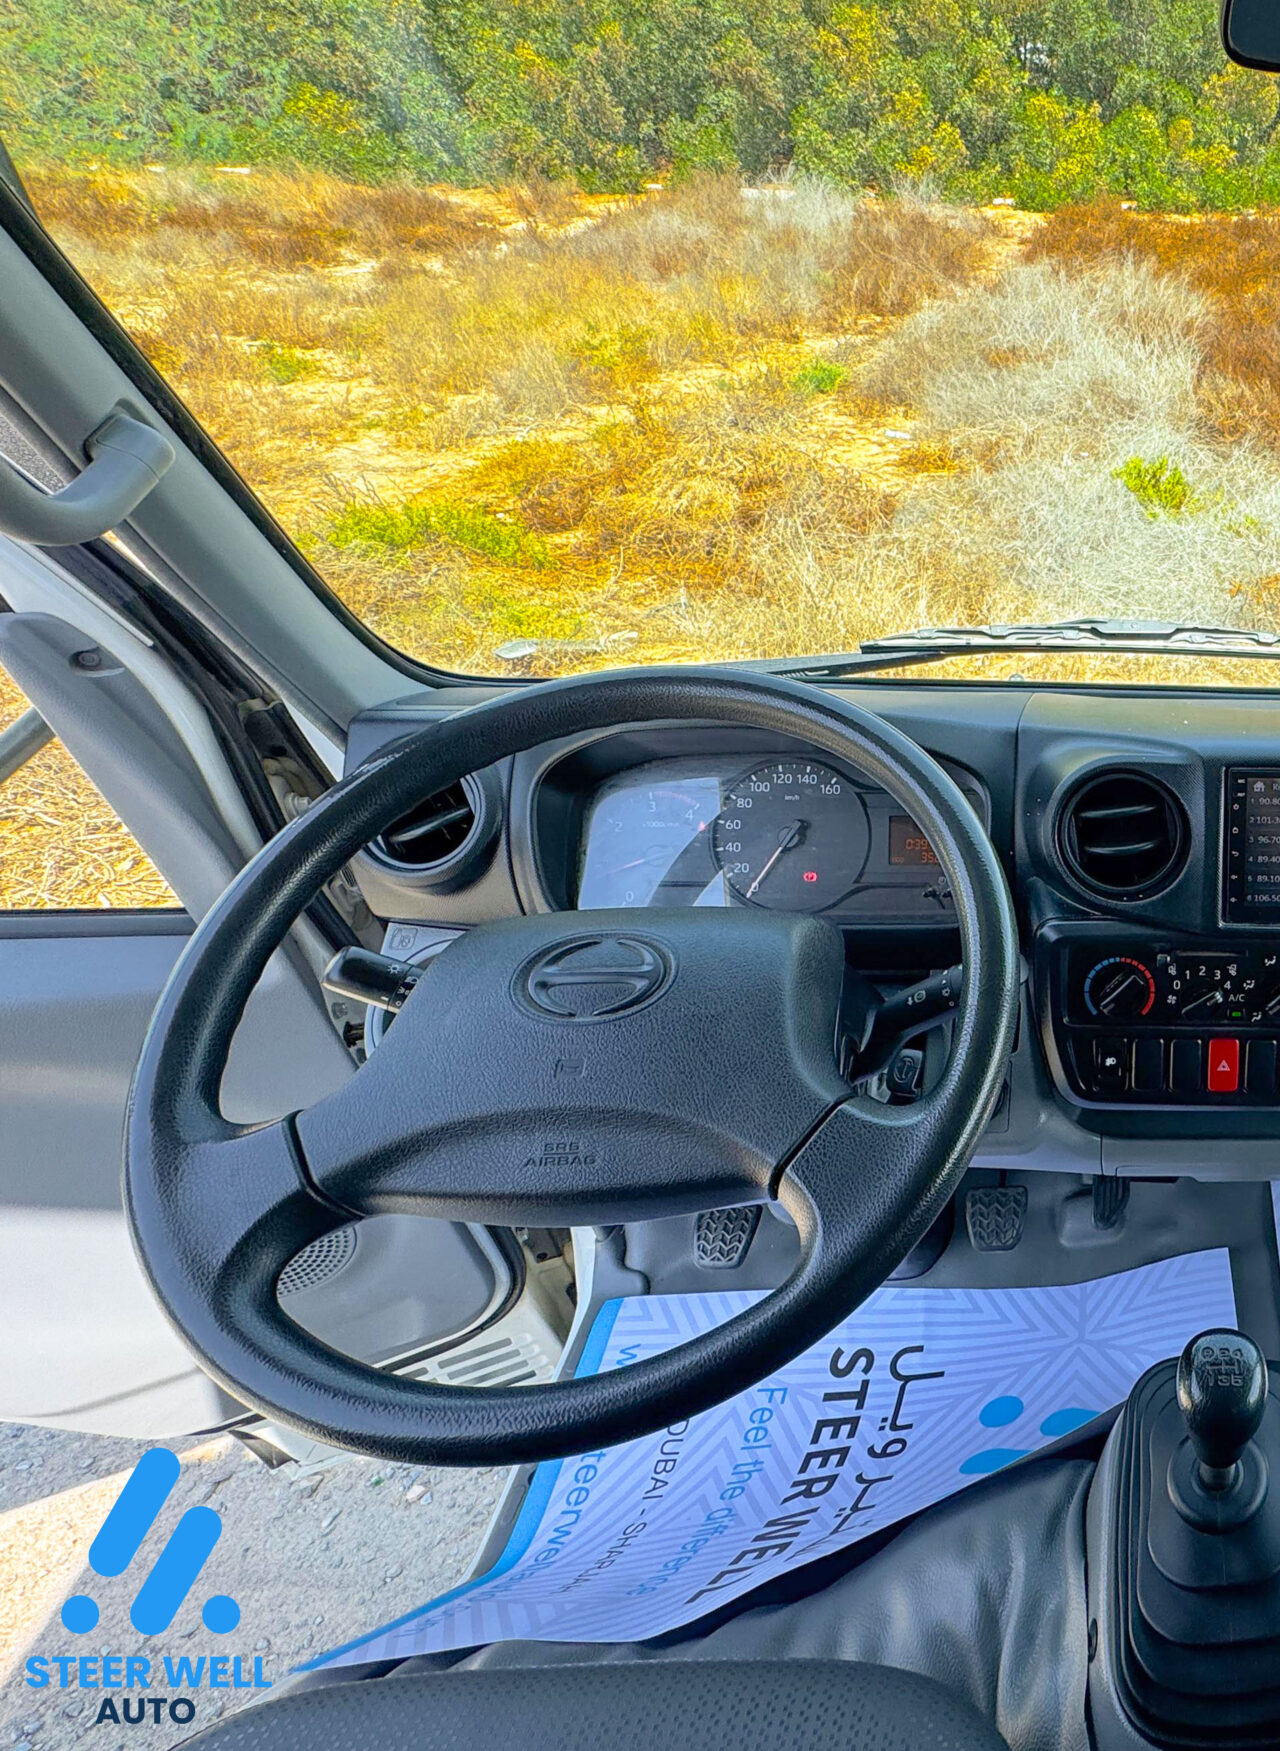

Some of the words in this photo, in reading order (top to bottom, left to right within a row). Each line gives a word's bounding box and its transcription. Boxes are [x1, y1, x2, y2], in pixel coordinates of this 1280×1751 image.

[772, 774, 793, 784] 120
[797, 774, 818, 784] 140
[749, 782, 770, 793] 100
[820, 785, 841, 795] 160
[649, 802, 657, 812] 3
[736, 798, 753, 808] 80
[685, 810, 694, 821] 4
[615, 821, 624, 832] 2
[725, 820, 741, 830] 60
[725, 842, 741, 852] 40
[734, 863, 750, 873] 20
[625, 890, 634, 902] 0
[1173, 980, 1181, 990] 0
[1185, 970, 1191, 980] 1
[1199, 966, 1206, 976] 2
[1213, 970, 1221, 980] 3
[1223, 980, 1231, 990] 4
[1228, 993, 1245, 1002] A/C
[523, 1155, 596, 1167] AIRBAG
[740, 1387, 788, 1451] Feel
[779, 1346, 875, 1505] STEER
[642, 1418, 691, 1500] DUBAI
[719, 1458, 764, 1501] the
[549, 1521, 648, 1594] SHARJAH
[684, 1506, 820, 1605] WELL
